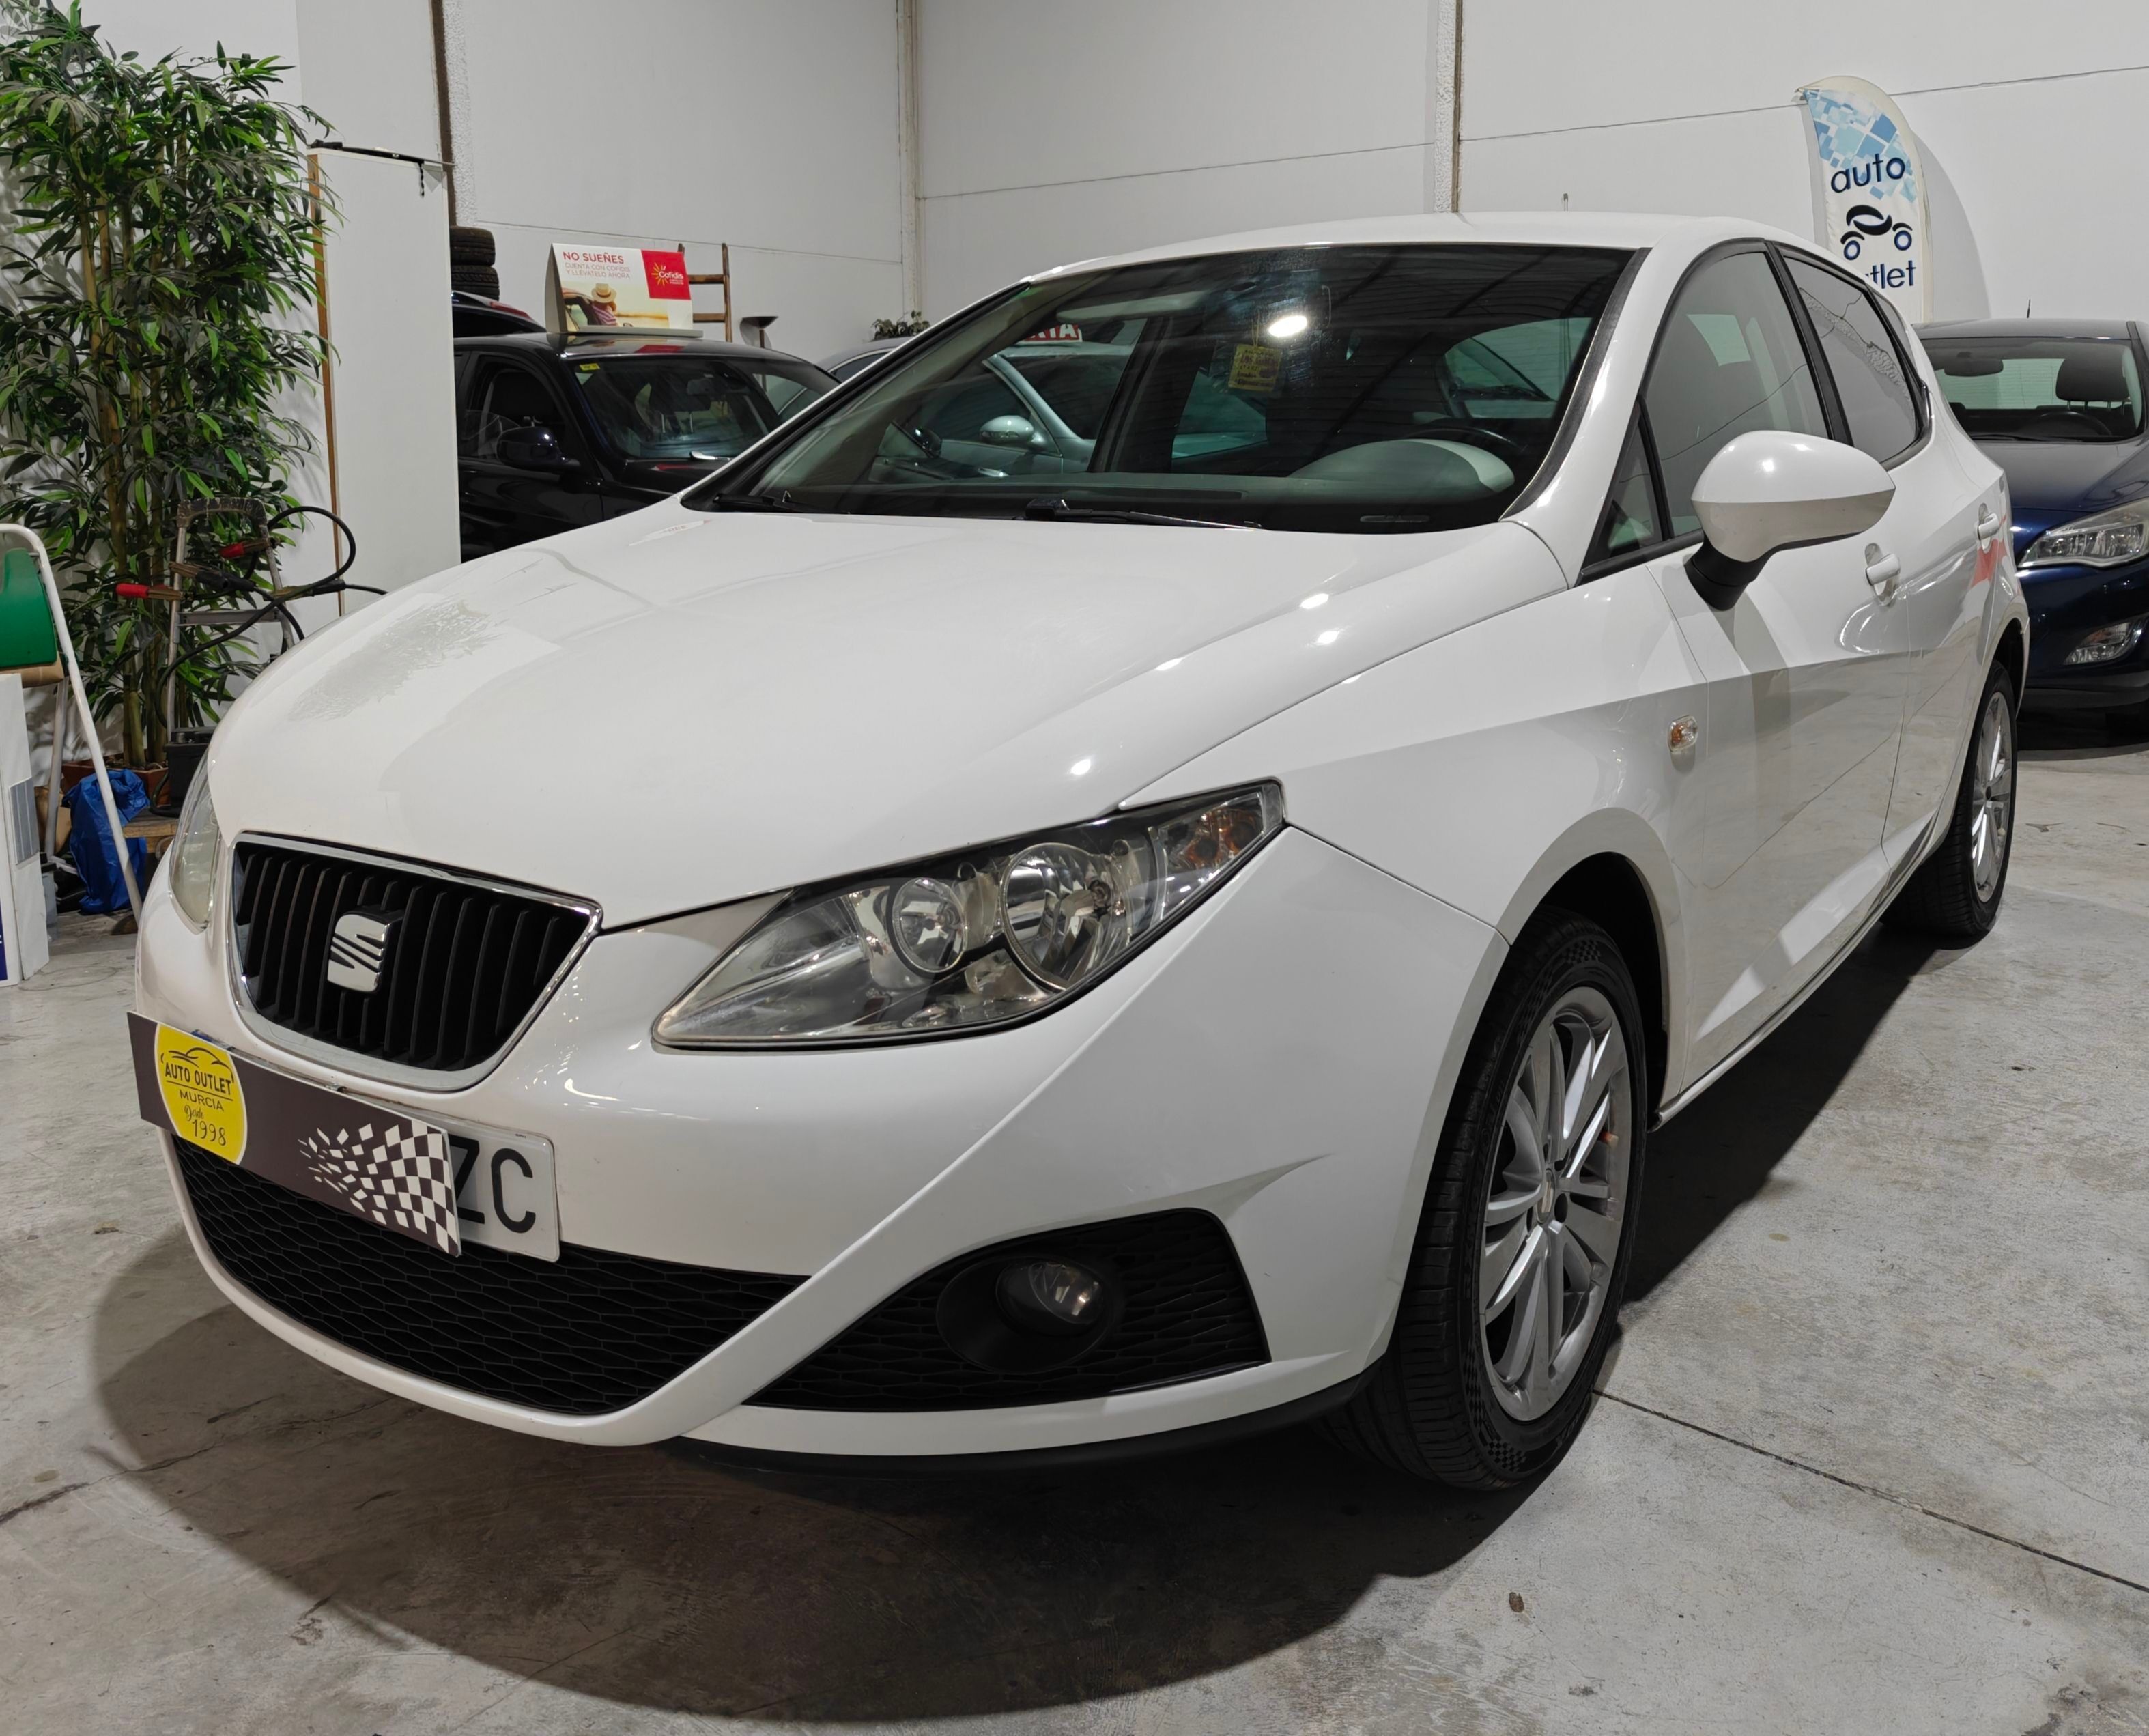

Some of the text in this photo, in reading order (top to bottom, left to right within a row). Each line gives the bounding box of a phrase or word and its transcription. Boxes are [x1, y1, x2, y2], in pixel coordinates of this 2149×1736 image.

[1831, 153, 1906, 193] auto
[563, 251, 624, 264] NO SUEÑES
[659, 271, 684, 279] Cofidis
[1865, 260, 1916, 289] tlet
[165, 1062, 231, 1095] AUTO OUTLET
[179, 1089, 224, 1111] MURCIA
[192, 1120, 226, 1146] 1998
